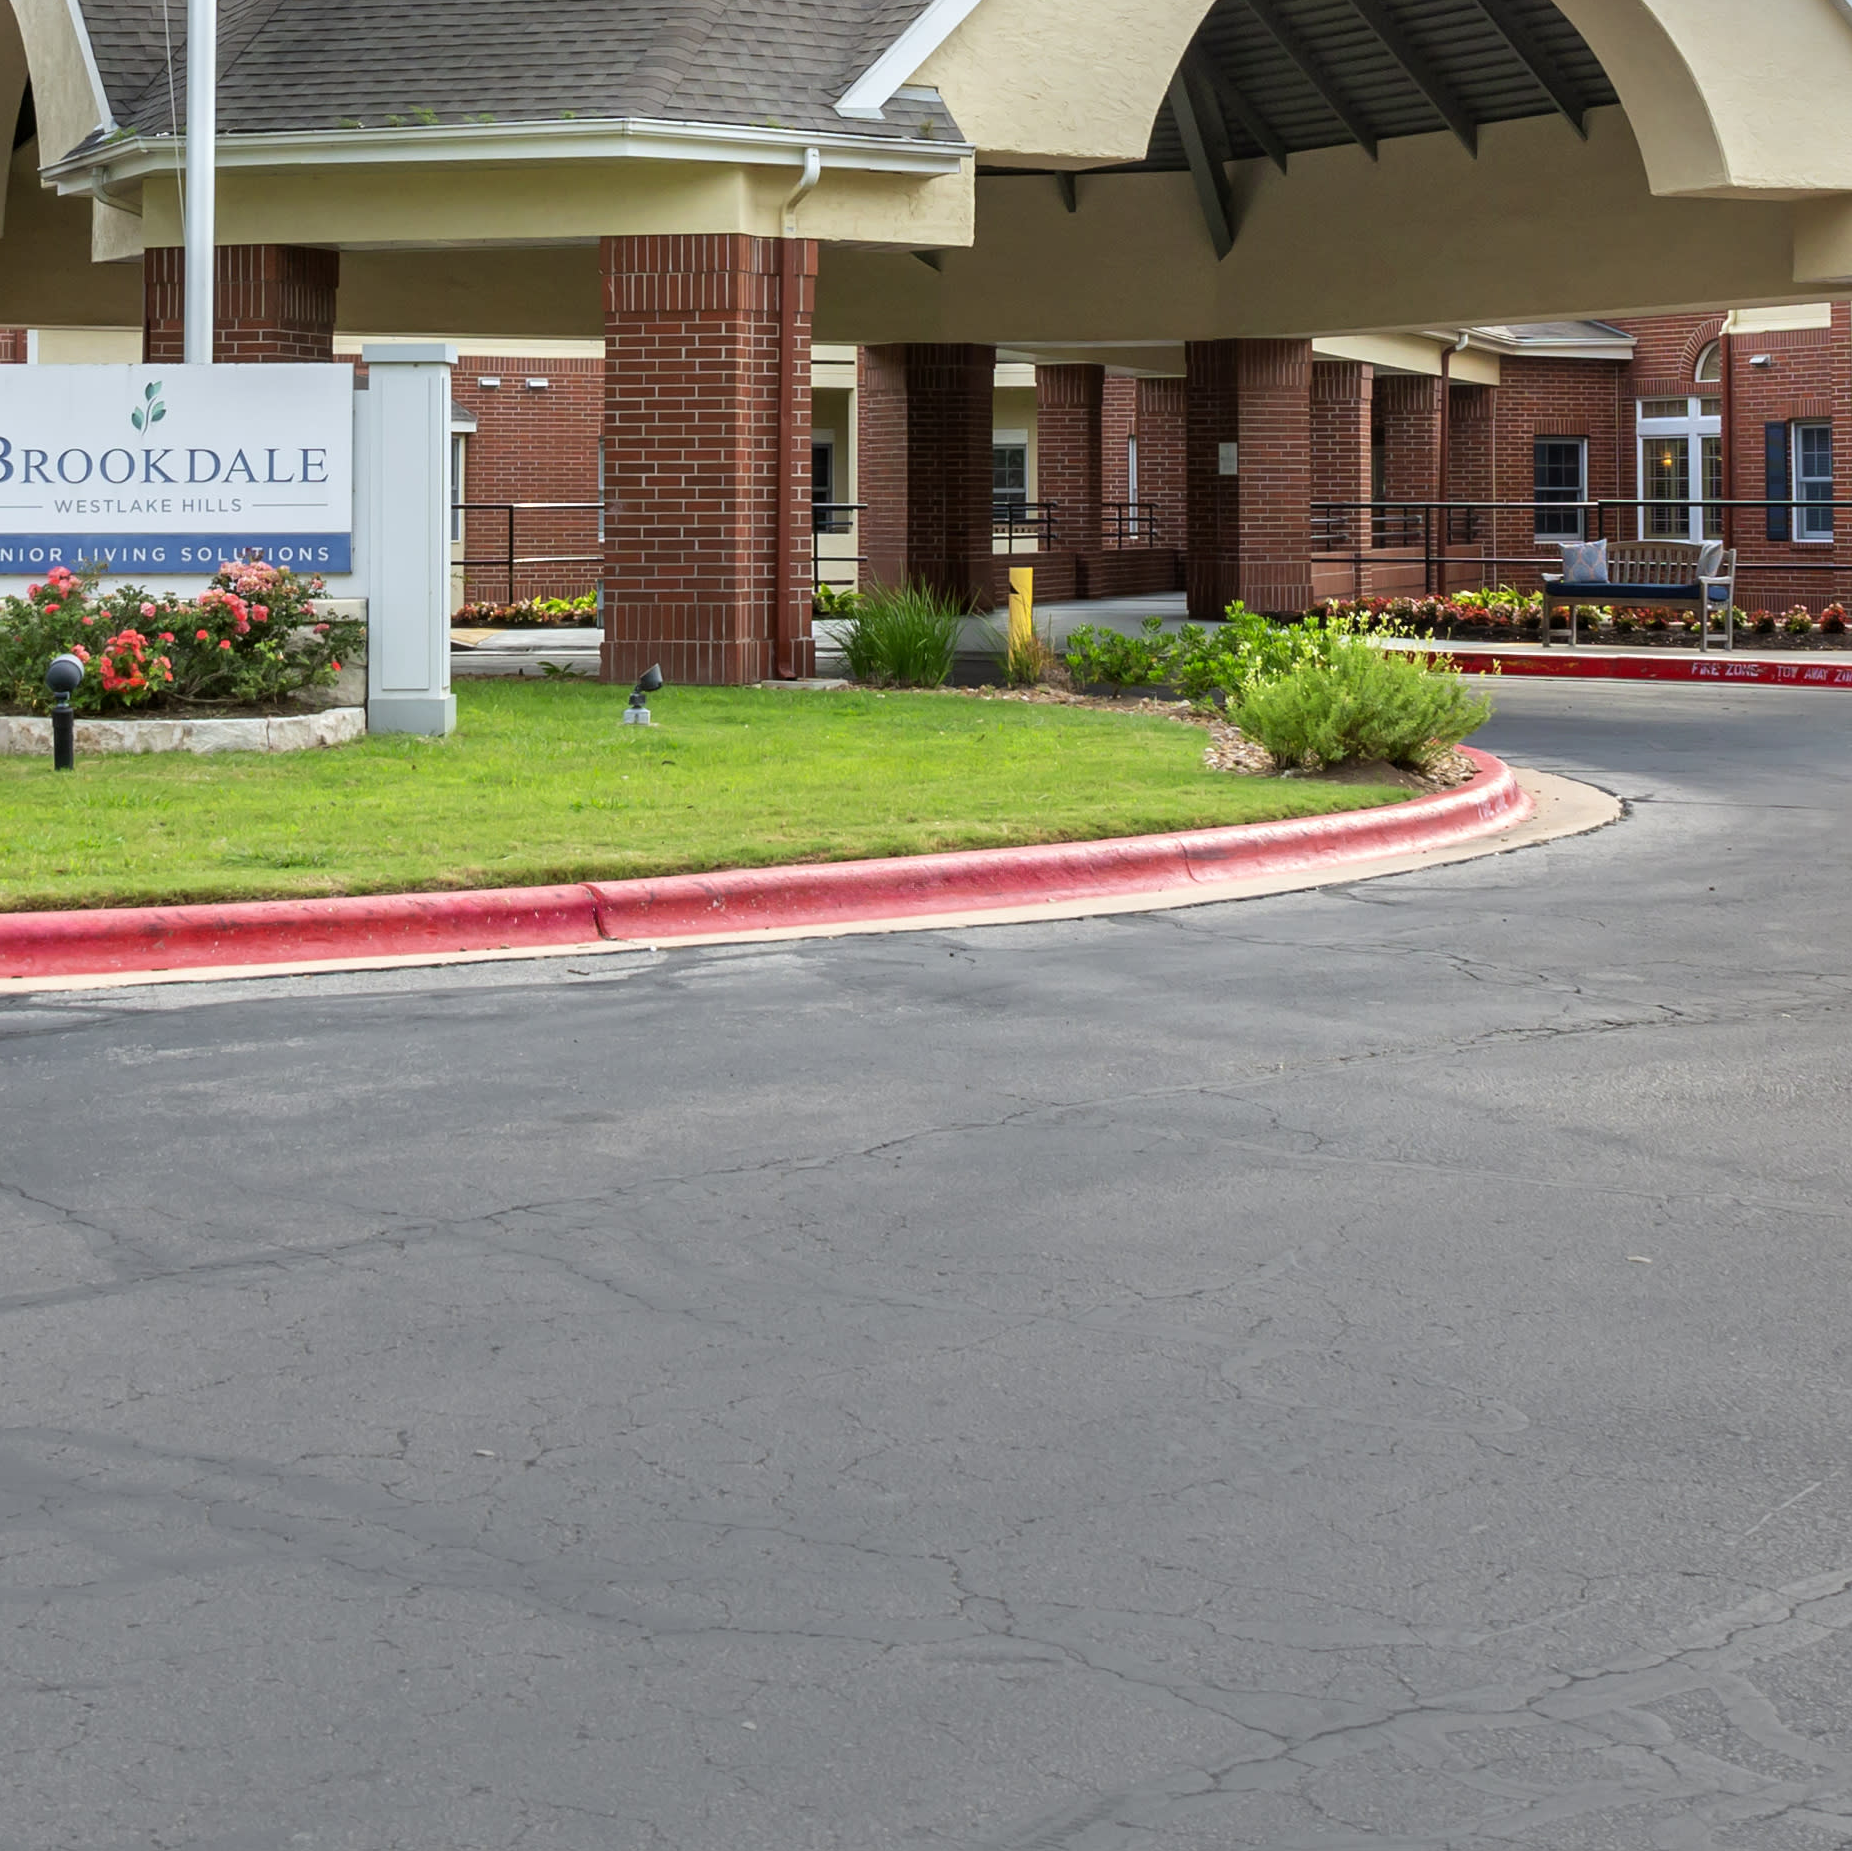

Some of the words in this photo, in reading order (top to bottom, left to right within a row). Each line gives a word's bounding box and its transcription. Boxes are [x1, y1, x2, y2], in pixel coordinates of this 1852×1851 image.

[54, 498, 172, 514] WESTLAKE
[182, 498, 242, 513] HILLS
[78, 547, 166, 562] LIVING
[181, 547, 329, 562] SOLUTIONS
[1691, 662, 1721, 676] FIRE
[1725, 663, 1759, 677] ZONE
[1804, 668, 1829, 681] AWAY
